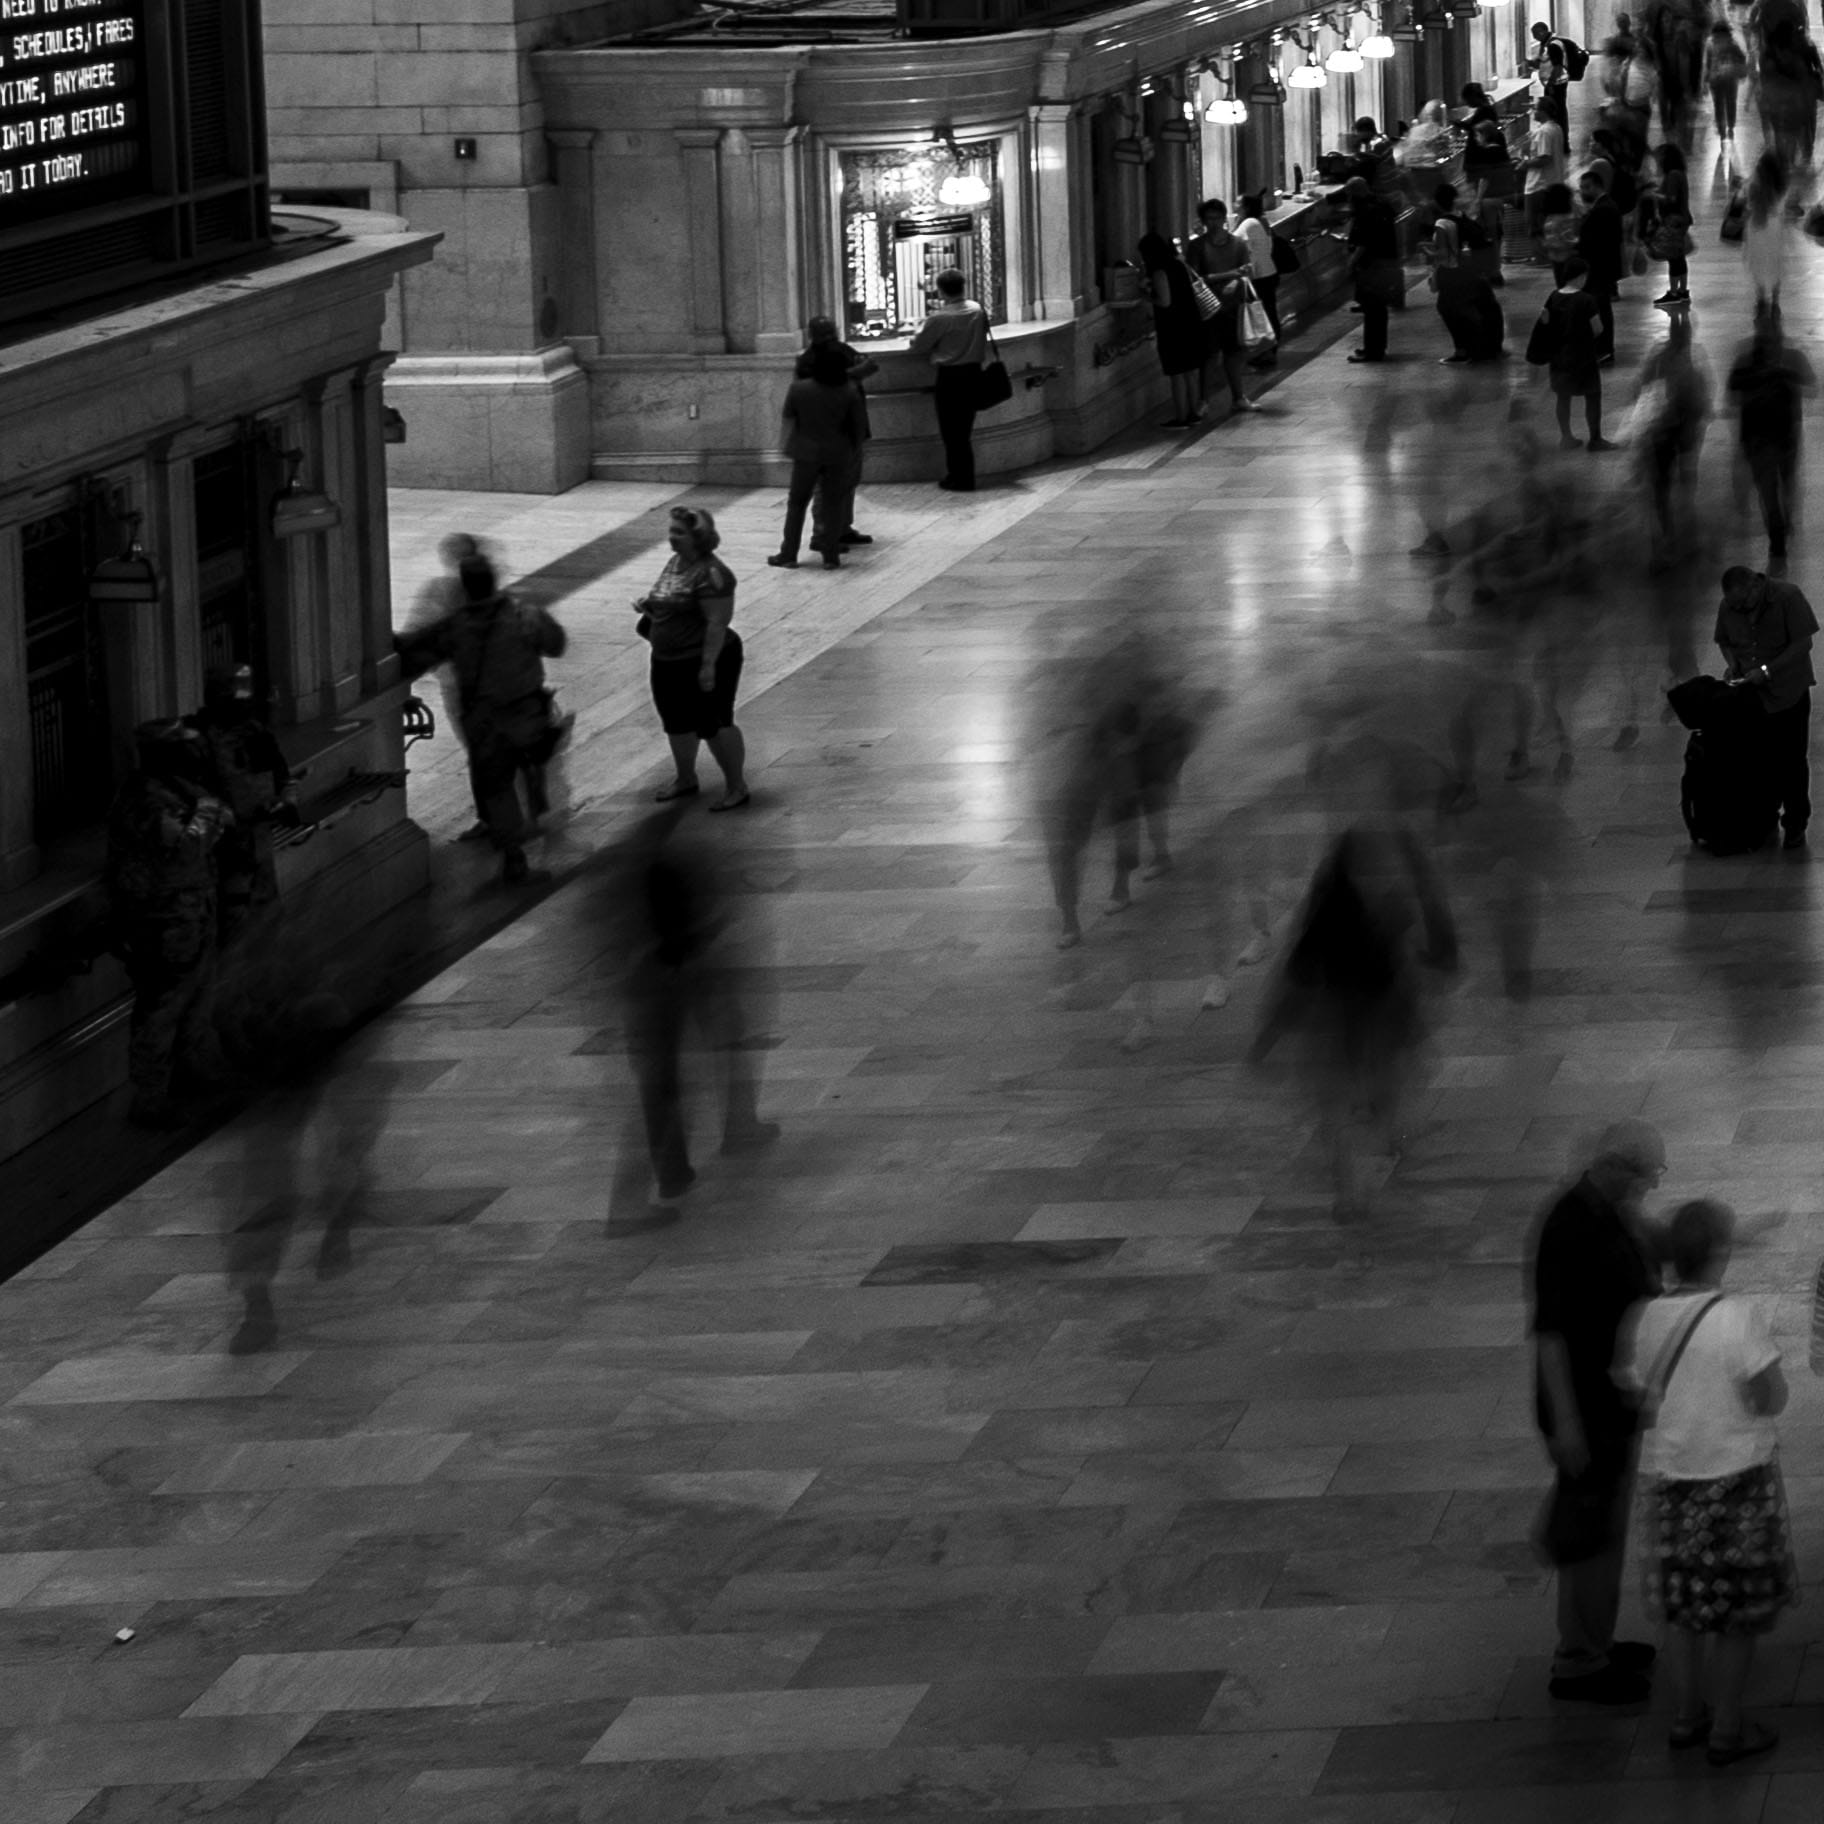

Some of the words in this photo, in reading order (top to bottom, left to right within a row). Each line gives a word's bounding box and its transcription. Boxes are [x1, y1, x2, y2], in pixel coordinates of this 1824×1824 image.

[96, 18, 134, 46] FARES
[54, 62, 116, 97] ANYWHERE
[40, 114, 66, 143] FOR
[71, 102, 125, 136] DETAILS
[20, 163, 36, 190] IT
